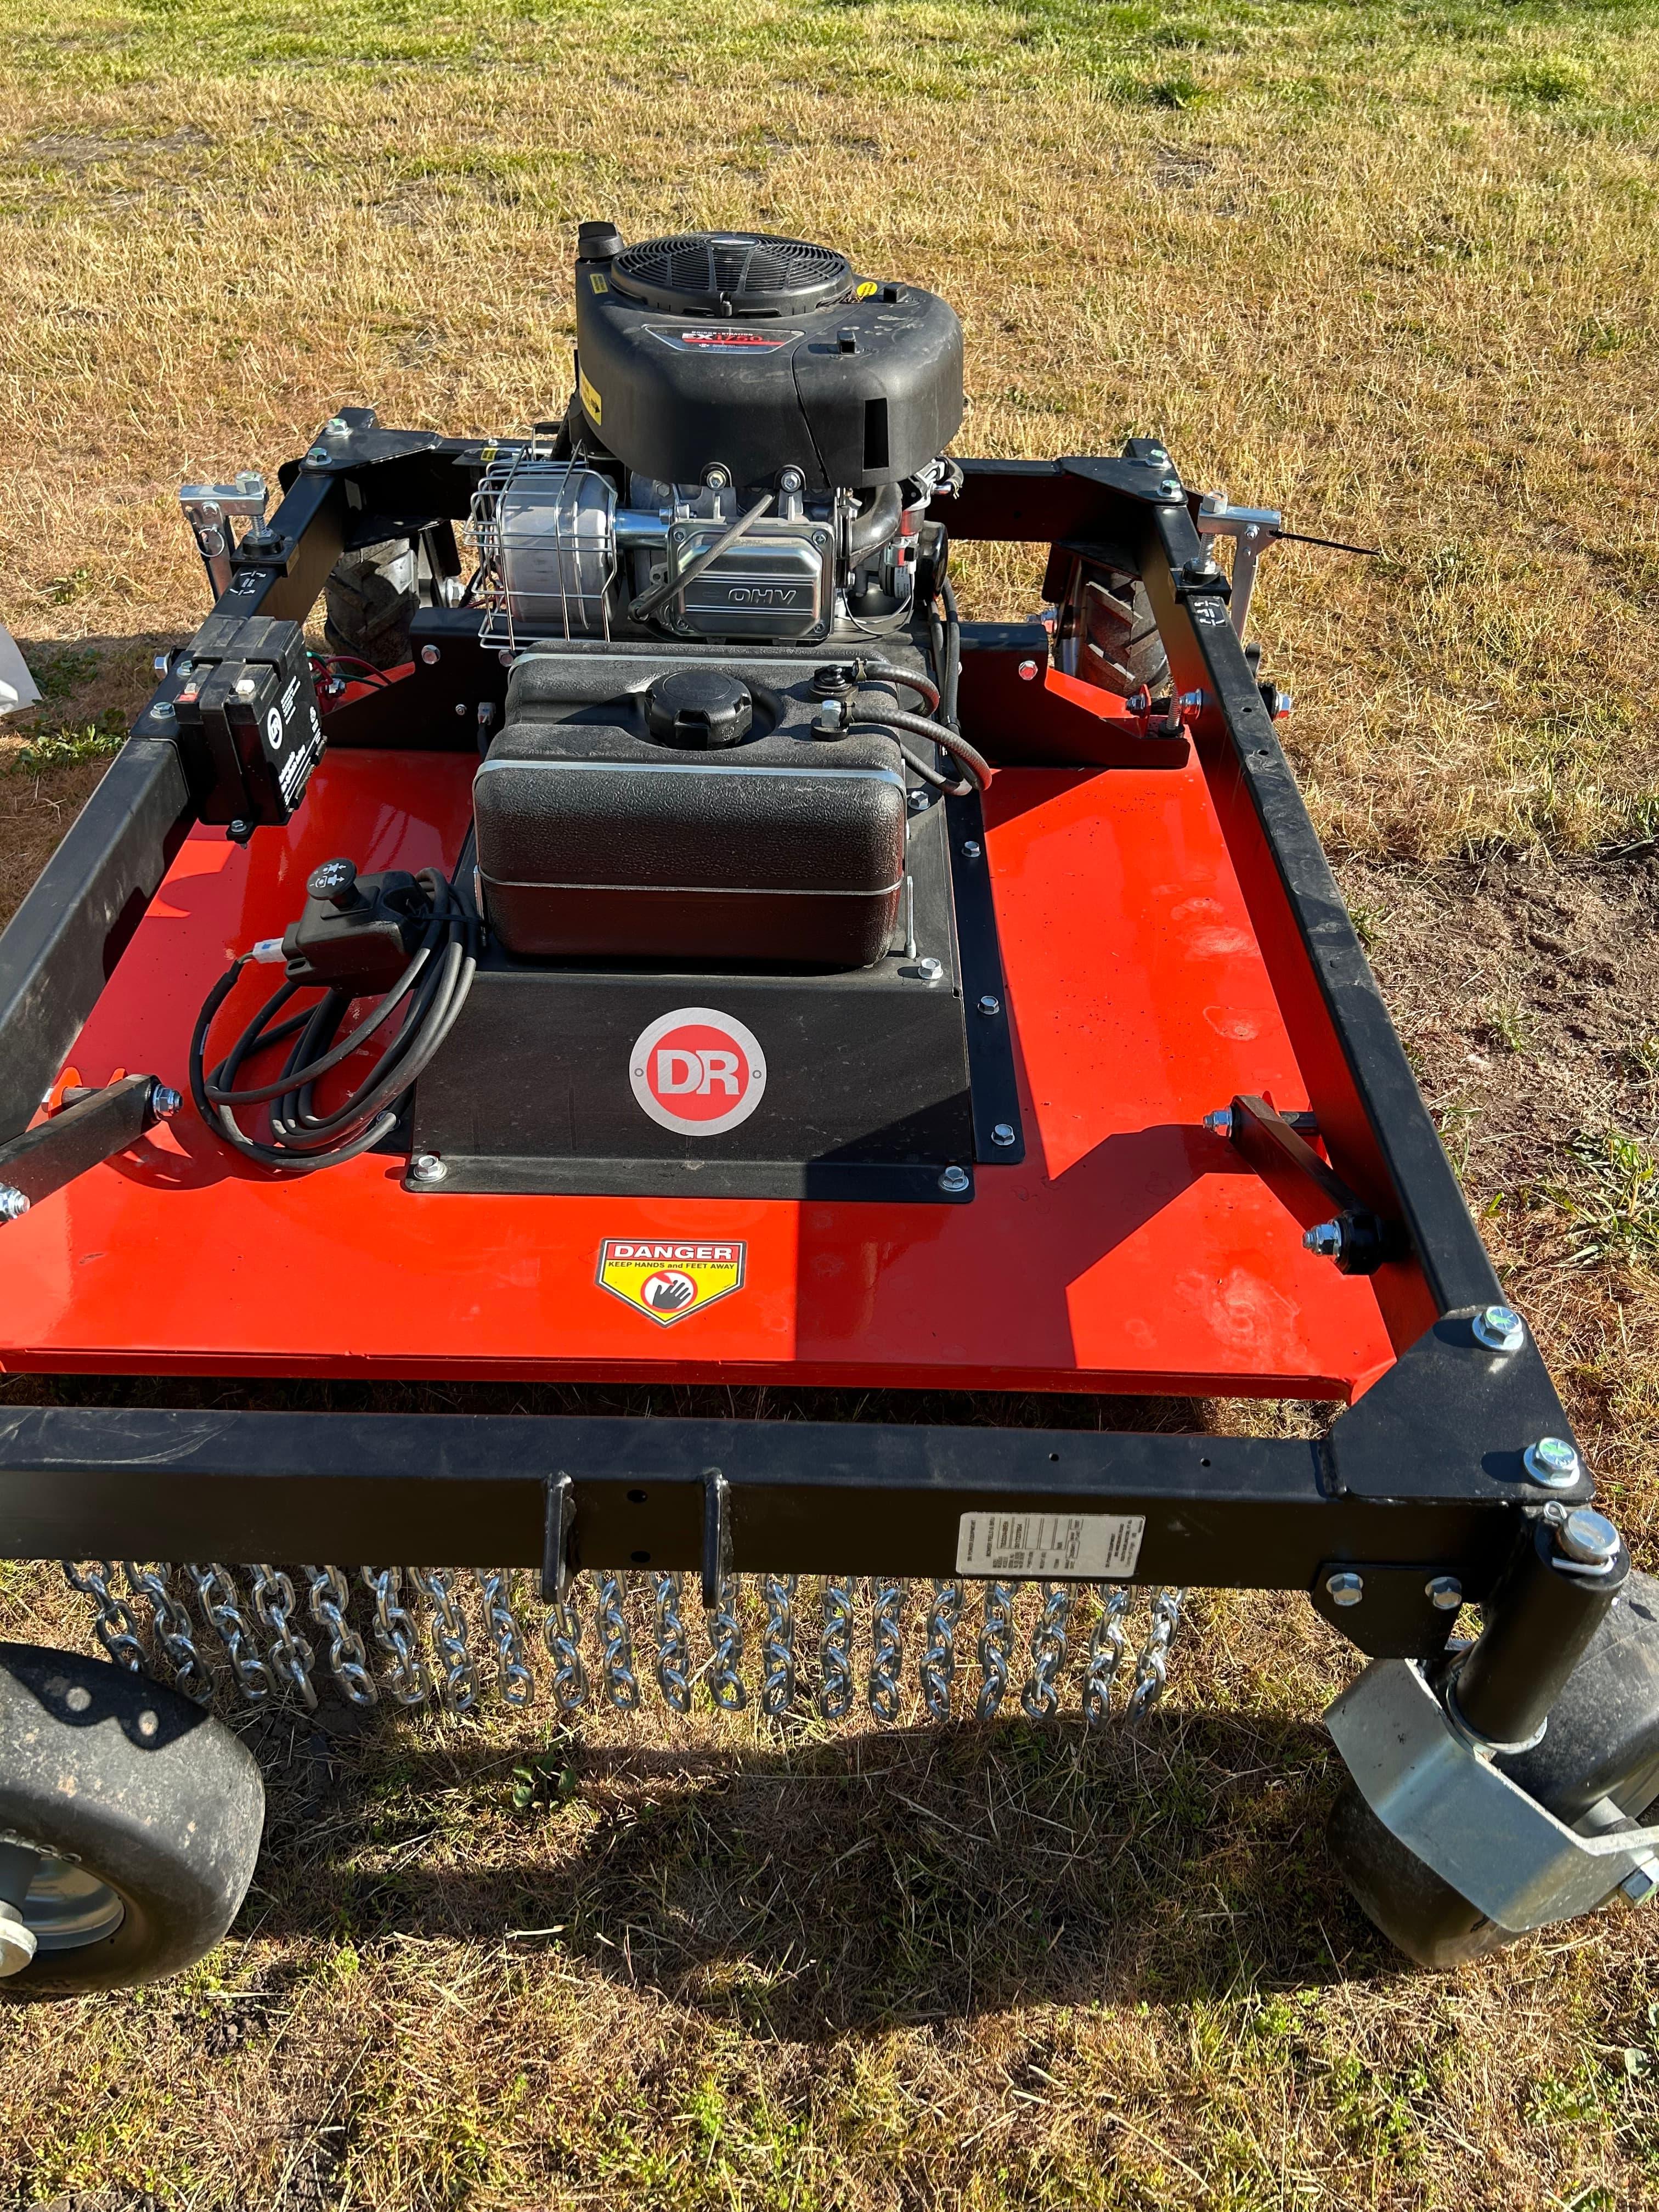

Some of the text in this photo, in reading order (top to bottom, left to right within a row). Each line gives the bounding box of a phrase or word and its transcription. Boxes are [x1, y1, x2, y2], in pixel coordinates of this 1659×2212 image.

[728, 588, 797, 604] OHV
[657, 1049, 740, 1095] DR
[614, 1245, 732, 1260] DANGER
